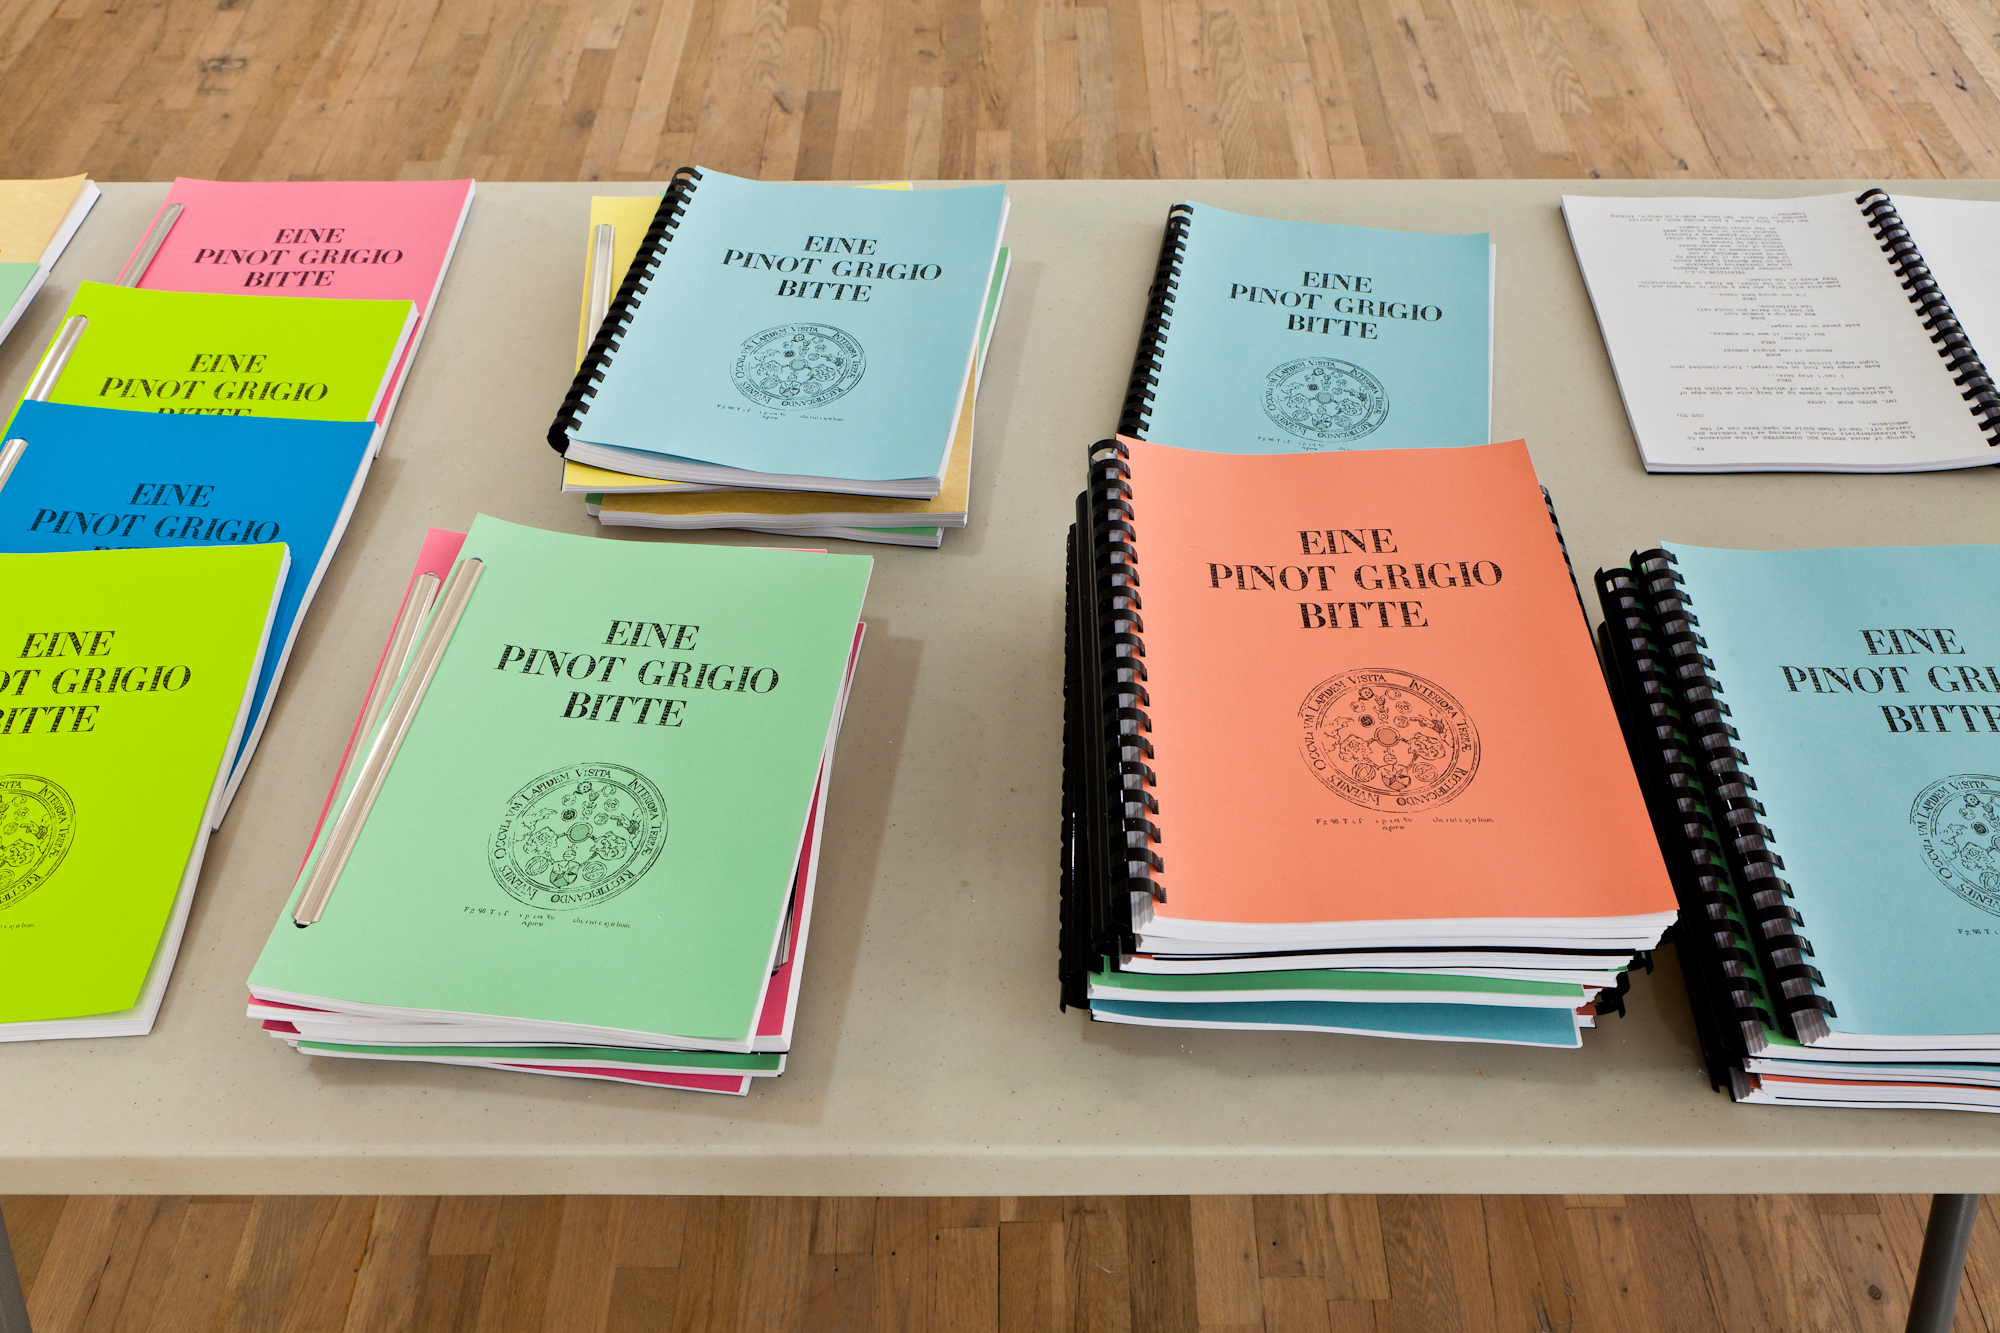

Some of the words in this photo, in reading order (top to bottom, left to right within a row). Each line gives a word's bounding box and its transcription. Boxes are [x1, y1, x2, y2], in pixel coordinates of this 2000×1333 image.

[273, 229, 346, 243] EINE
[803, 236, 878, 255] EINE
[192, 249, 291, 265] PINOT
[297, 249, 404, 264] GRIGIO
[721, 249, 823, 274] PINOT
[830, 261, 943, 280] GRIGIO
[242, 271, 336, 287] BITTE
[776, 280, 872, 302] BITTE
[1301, 271, 1373, 293] EINE
[1229, 283, 1323, 309] PINOT
[1332, 297, 1443, 321] GRIGIO
[1286, 314, 1378, 339] BITTE
[188, 354, 268, 373] EINE
[98, 377, 206, 399] PINOT
[212, 382, 329, 401] GRIGIO
[125, 483, 216, 507] EINE
[28, 509, 146, 539] PINOT
[154, 517, 280, 545] GRIGIO
[1295, 529, 1398, 555] EINE
[1205, 563, 1336, 591] PINOT
[1352, 561, 1503, 590] GRIGIO
[1295, 601, 1429, 628] BITTE
[15, 631, 116, 658] EINE
[600, 620, 700, 650] EINE
[1858, 629, 1966, 655] EINE
[50, 666, 192, 694] GRIGIO
[495, 645, 627, 682] PINOT
[636, 660, 779, 693] GRIGIO
[1777, 666, 1909, 693] PINOT
[1926, 666, 2000, 692] GRI
[558, 692, 688, 727] BITTE
[0, 782, 22, 790] SITA
